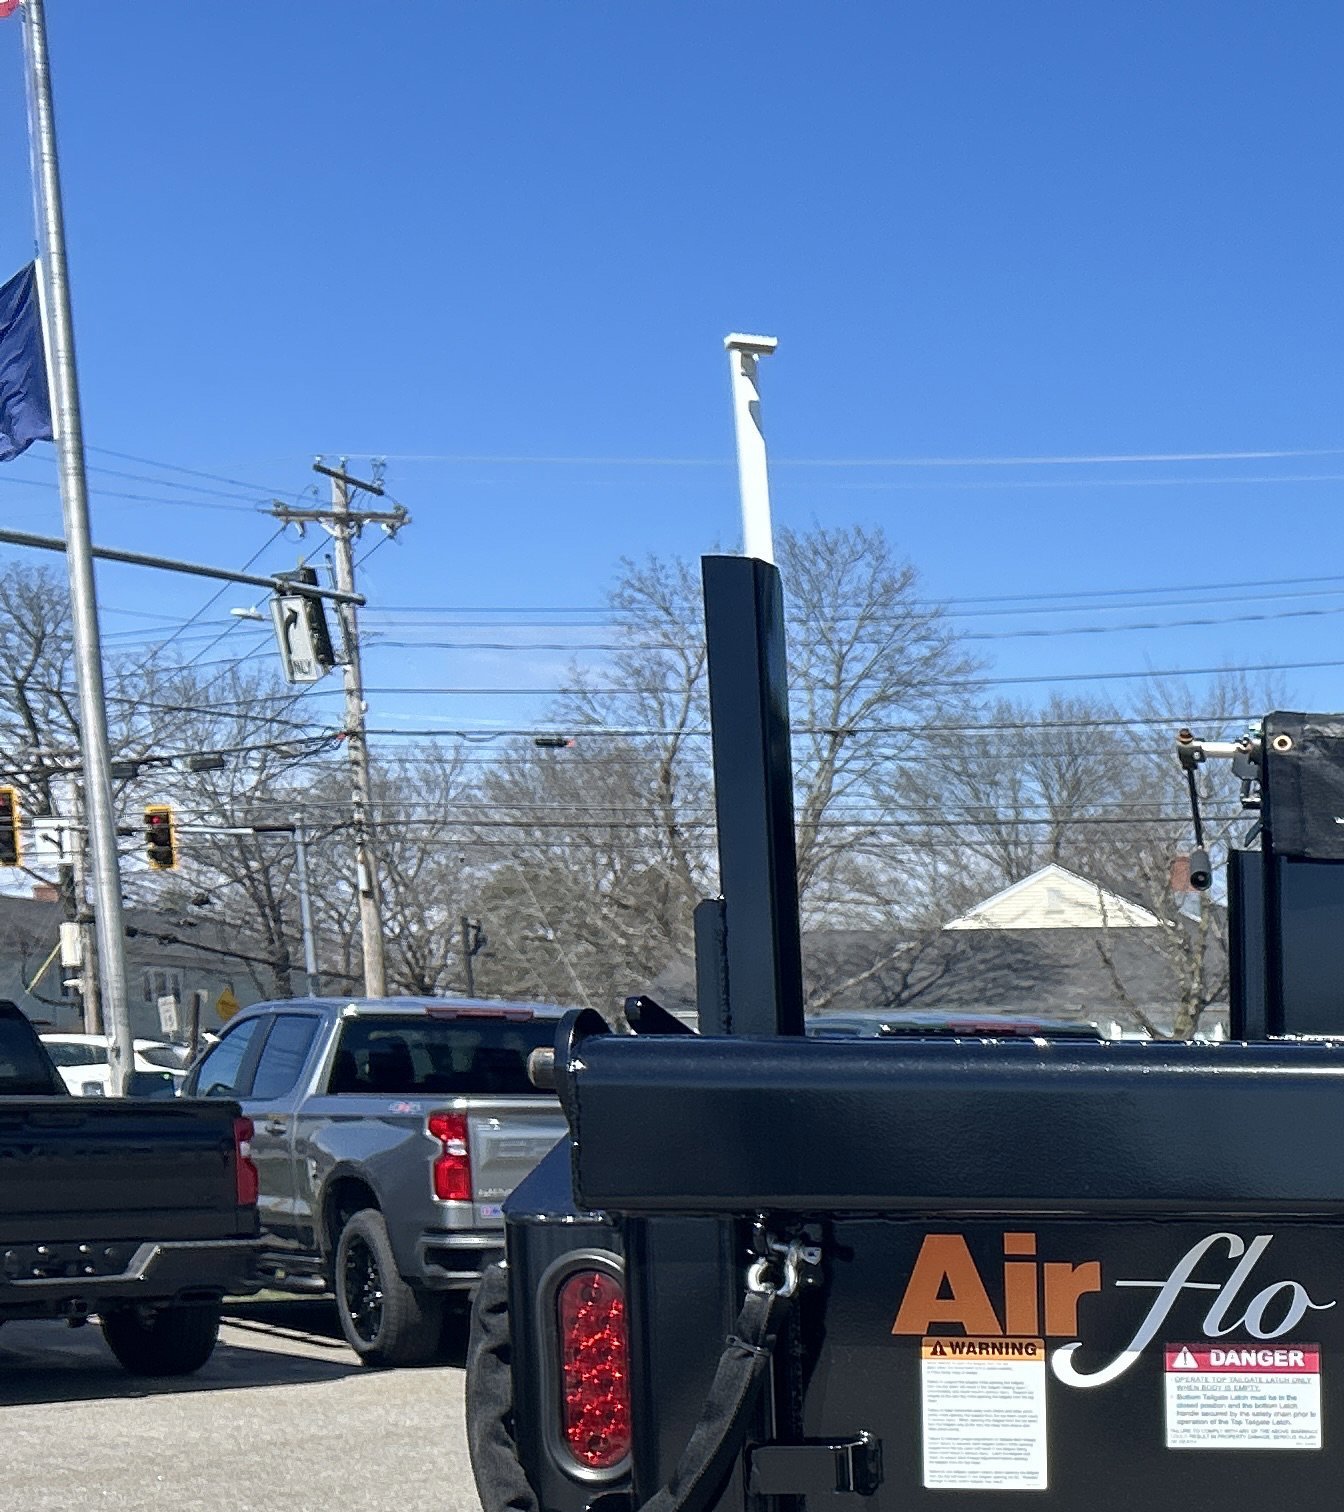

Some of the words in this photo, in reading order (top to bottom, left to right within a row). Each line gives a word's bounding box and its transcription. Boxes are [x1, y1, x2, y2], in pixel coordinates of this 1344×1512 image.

[892, 1232, 1101, 1336] Air
[1052, 1232, 1336, 1387] flo
[950, 1341, 1037, 1356] WARNING
[1210, 1349, 1305, 1367] DANGER
